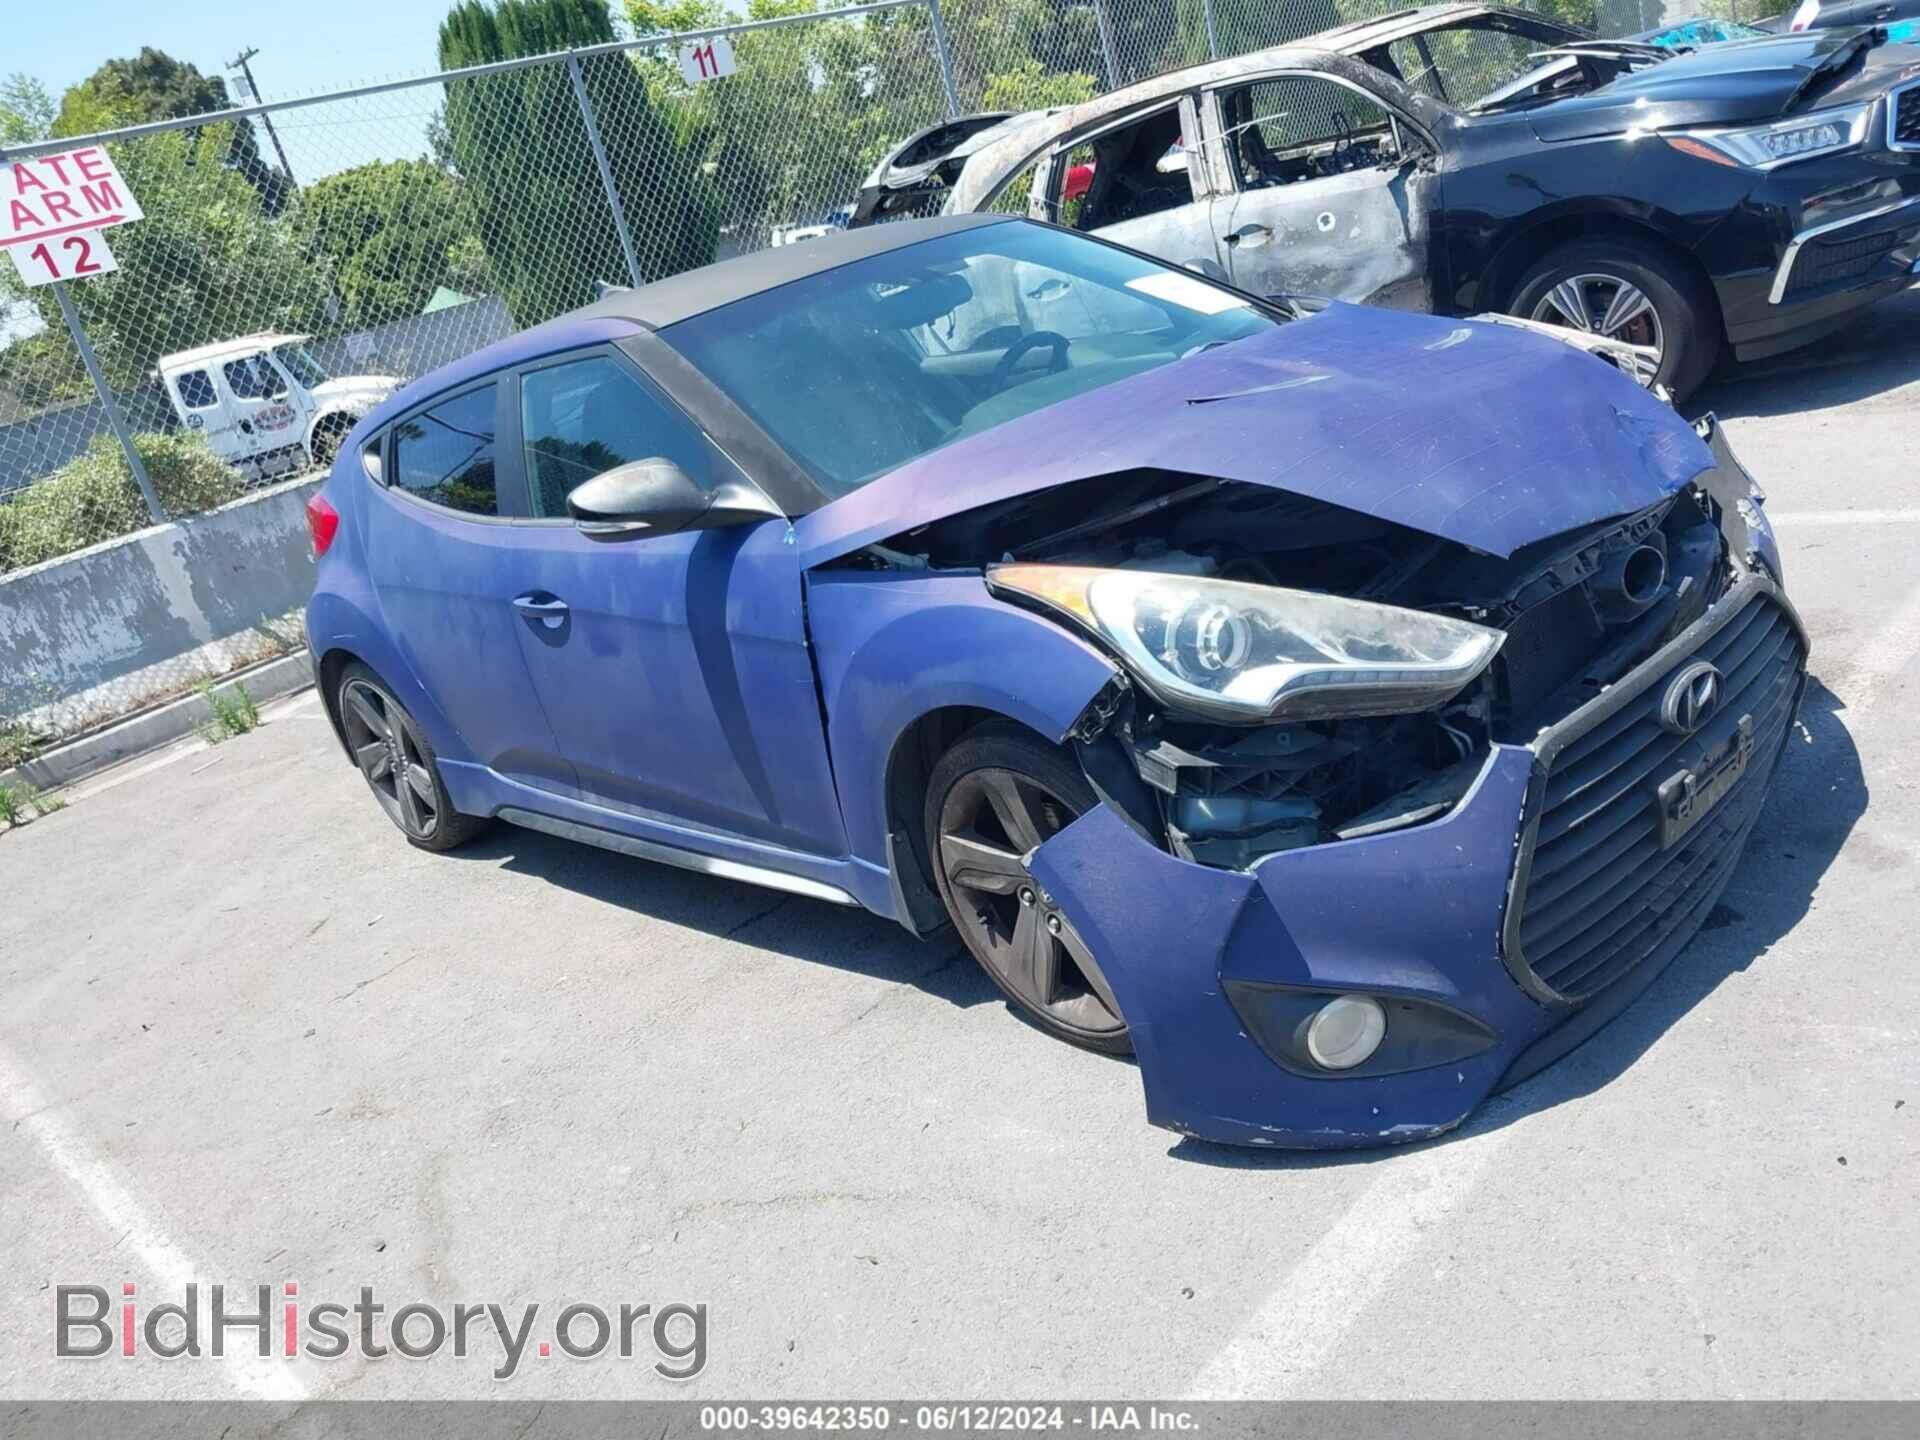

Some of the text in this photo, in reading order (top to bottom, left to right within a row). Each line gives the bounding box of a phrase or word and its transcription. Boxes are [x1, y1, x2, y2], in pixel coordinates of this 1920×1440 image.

[692, 45, 719, 78] 11
[13, 149, 112, 195] ATE
[10, 181, 123, 231] ARM
[31, 237, 101, 279] 12
